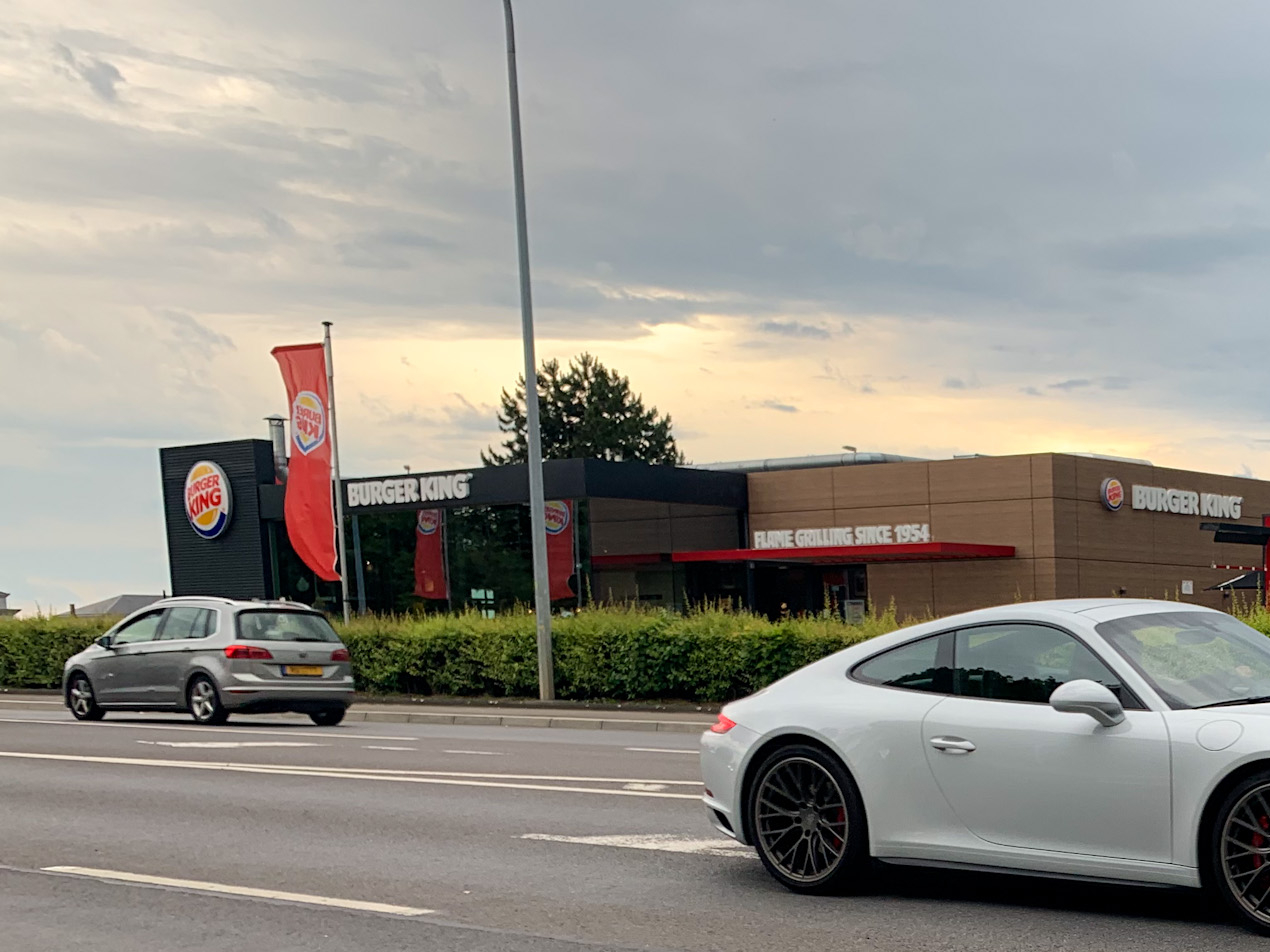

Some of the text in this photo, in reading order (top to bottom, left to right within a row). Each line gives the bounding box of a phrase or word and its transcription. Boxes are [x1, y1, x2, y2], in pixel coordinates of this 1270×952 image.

[188, 475, 220, 497] BURGER
[347, 473, 470, 507] BURGER KING
[1132, 485, 1241, 519] BURGER KING
[188, 488, 222, 520] KING
[754, 524, 930, 548] FLAME GRILLING SINCE 1954
